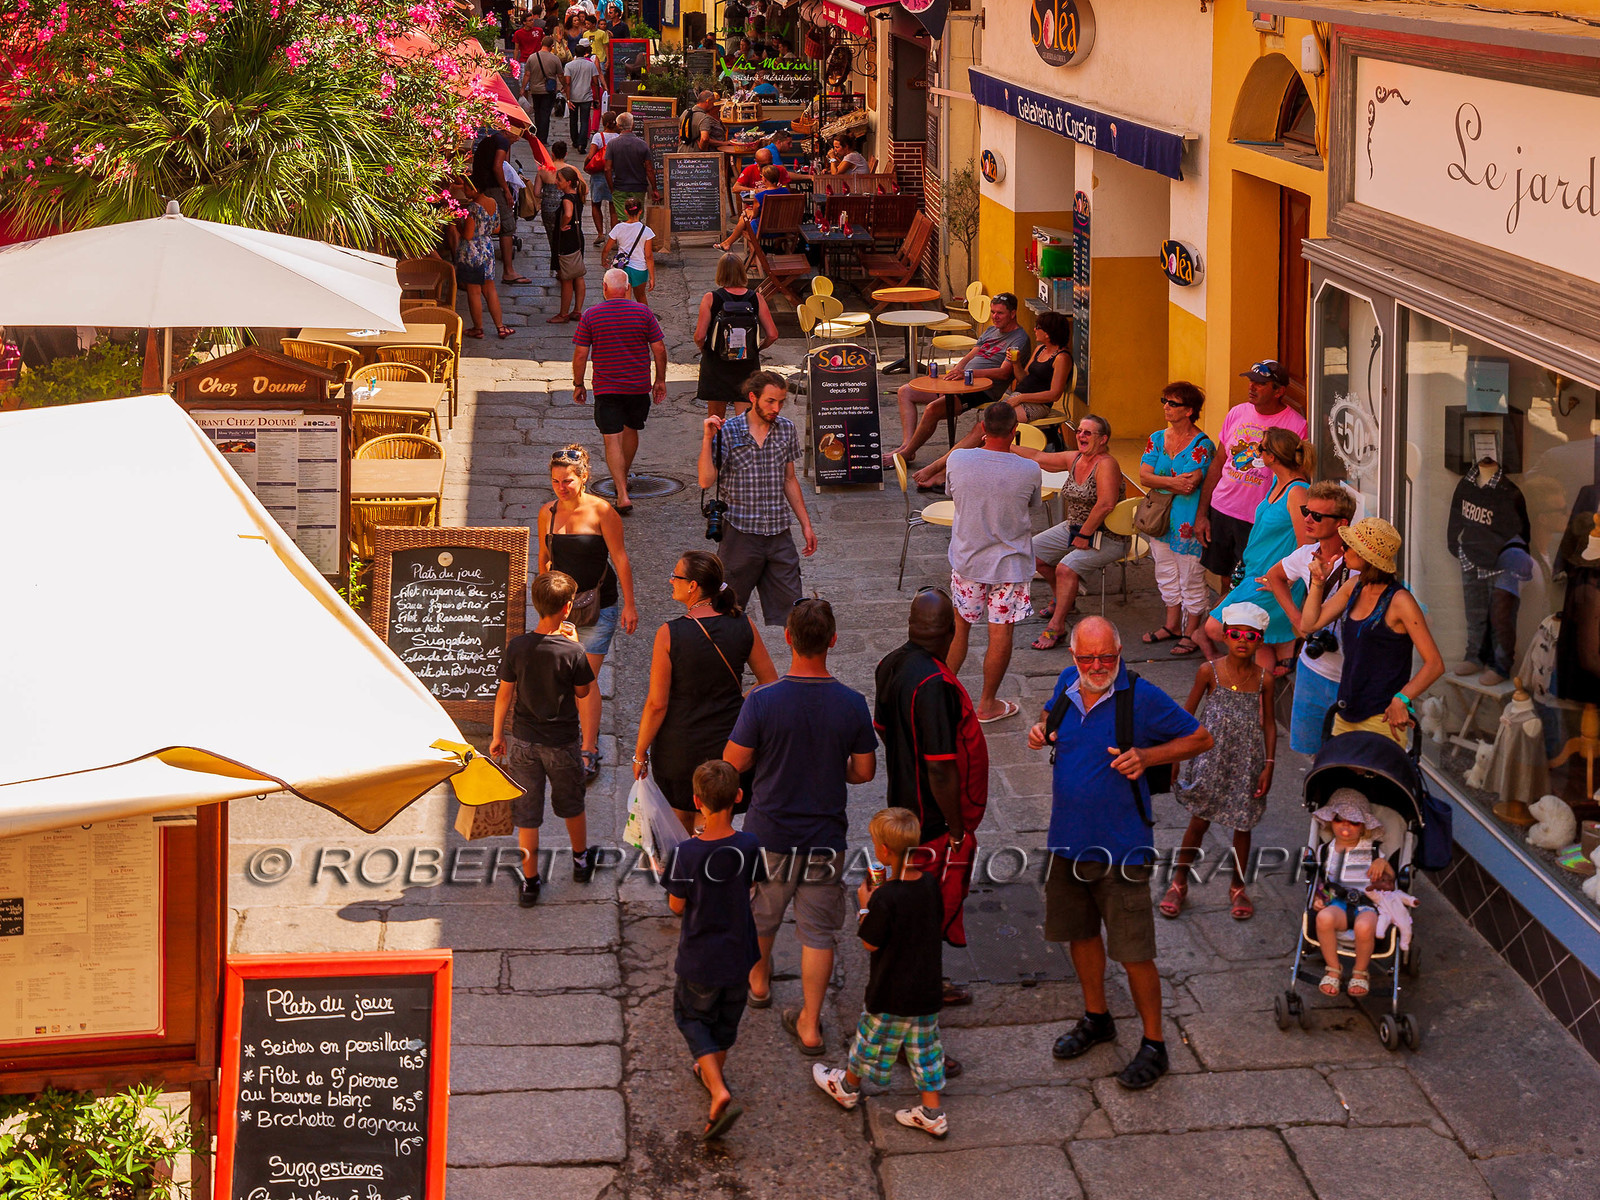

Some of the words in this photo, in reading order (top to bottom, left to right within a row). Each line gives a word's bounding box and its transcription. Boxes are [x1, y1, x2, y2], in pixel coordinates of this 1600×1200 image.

[719, 53, 756, 76] Via
[1017, 95, 1055, 128] Gelateria
[1064, 109, 1097, 146] Corsica
[1447, 102, 1507, 190] Le
[1160, 240, 1193, 283] Soléa
[818, 349, 868, 367] Soléa
[198, 376, 238, 397] Chez
[252, 375, 308, 395] Doumé
[226, 417, 256, 426] CHEZ
[257, 416, 297, 427] DOUMÉ
[1461, 499, 1494, 526] HEROES
[411, 562, 437, 580] Plats
[438, 567, 454, 579] du
[422, 586, 453, 601] mignon
[397, 610, 418, 623] Filet
[266, 988, 317, 1018] Plats
[320, 995, 345, 1012] du
[350, 993, 394, 1021] jour
[261, 1038, 315, 1056] Seiches
[258, 1064, 300, 1086] Filet
[306, 1070, 324, 1087] de
[348, 1073, 399, 1095] pierre
[270, 1086, 322, 1105] beurre
[257, 1109, 336, 1128] Brochette
[268, 1156, 384, 1188] Suggestions
